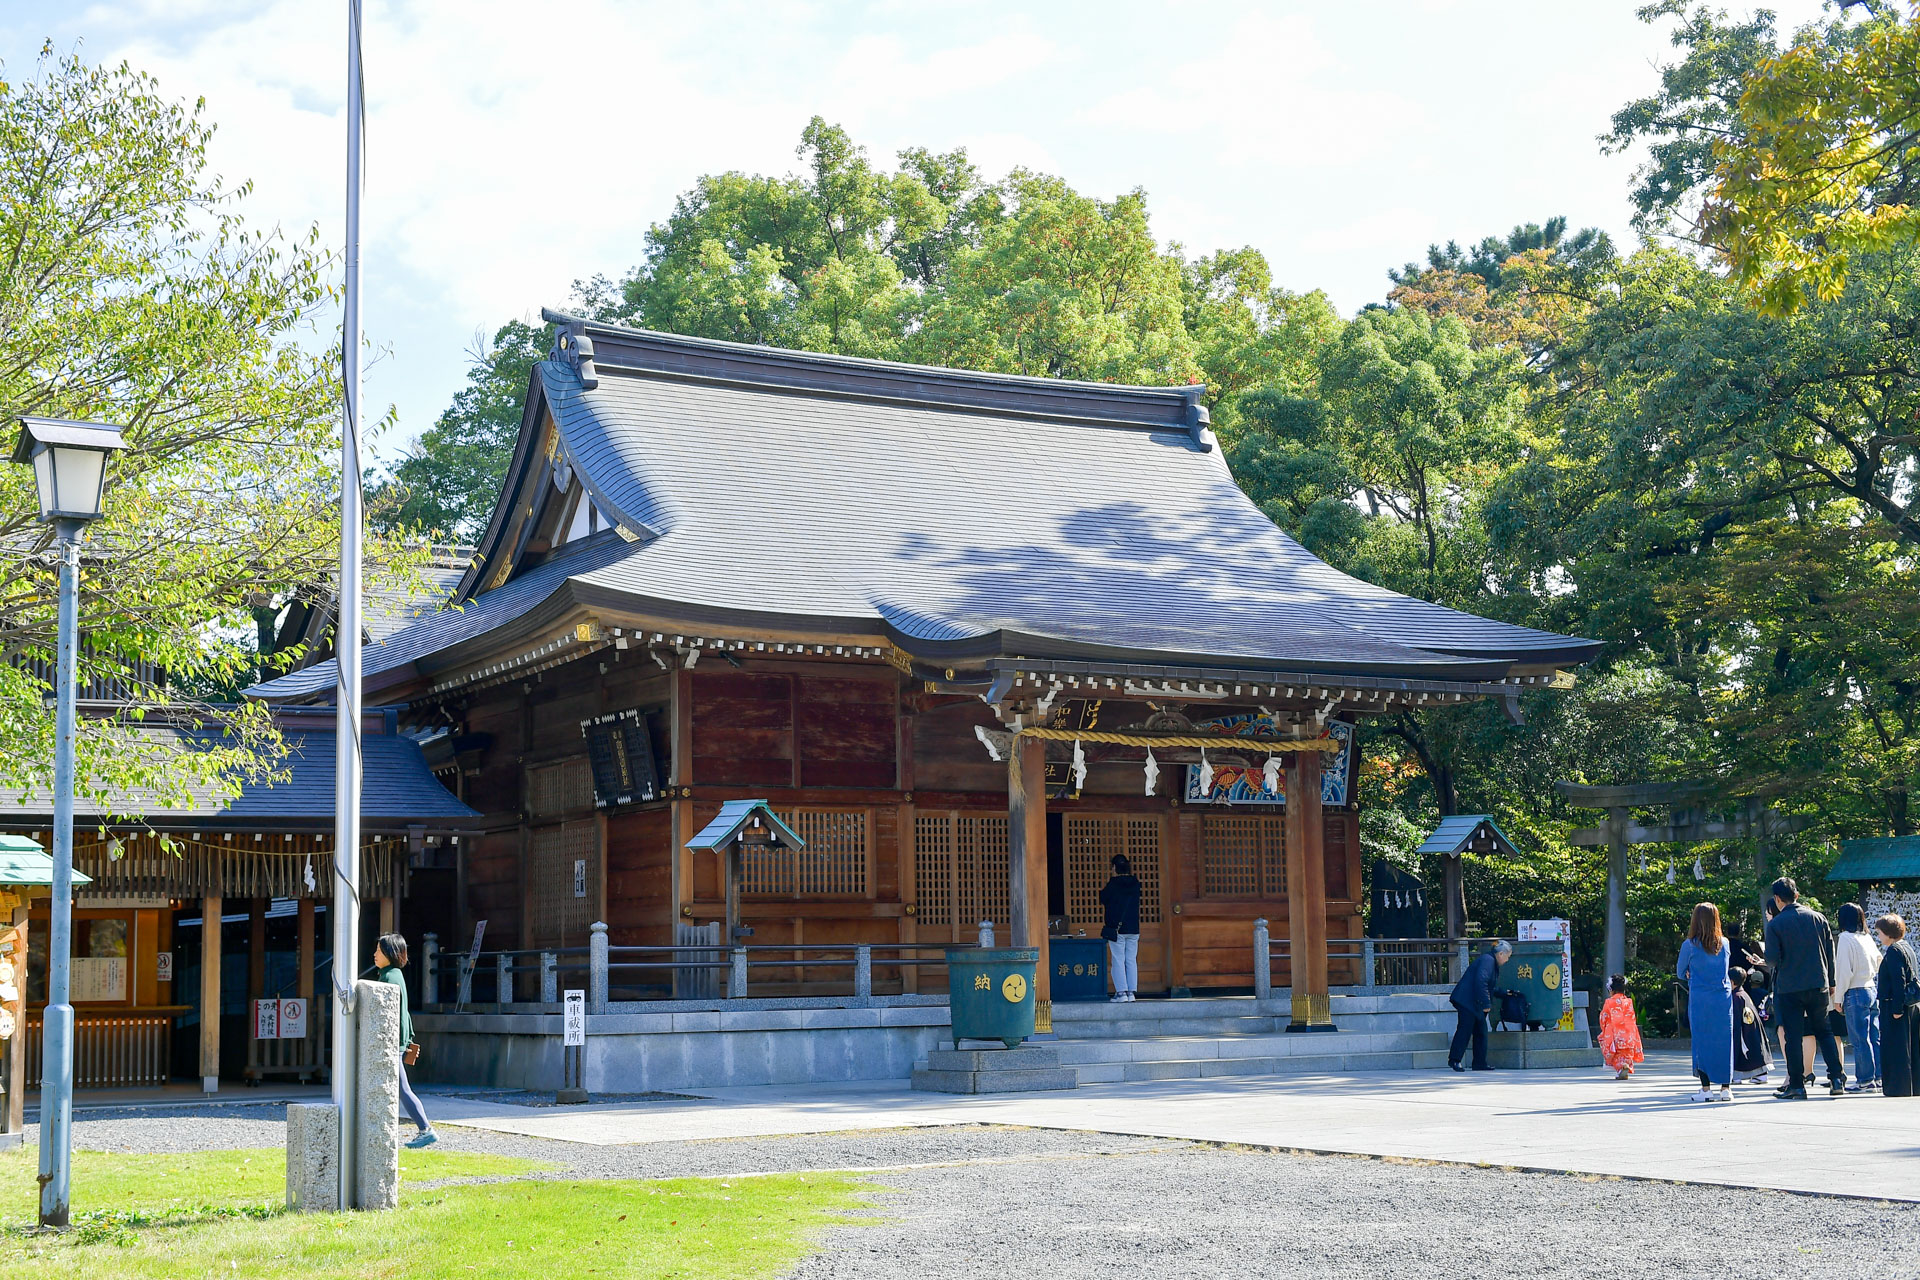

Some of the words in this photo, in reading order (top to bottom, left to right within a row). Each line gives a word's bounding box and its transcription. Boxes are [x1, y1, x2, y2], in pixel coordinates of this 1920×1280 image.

[1517, 963, 1533, 979] 納
[974, 973, 991, 991] 納
[568, 1003, 581, 1042] 車祓所
